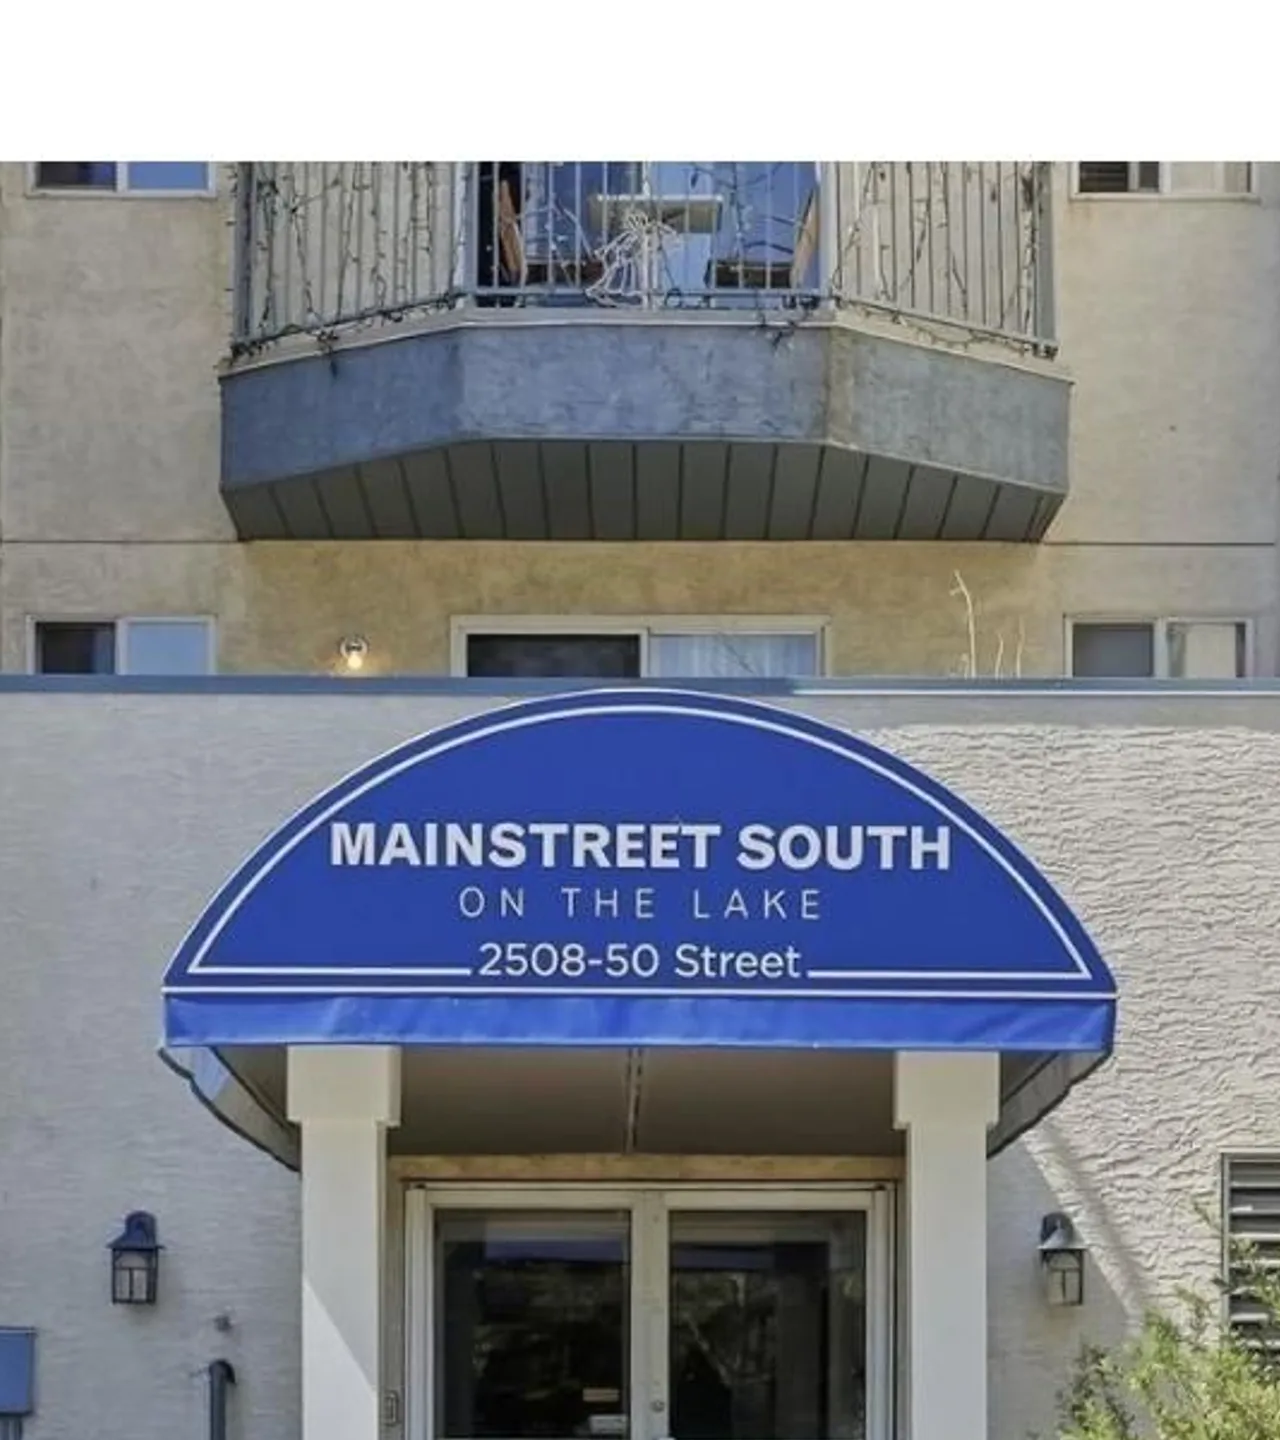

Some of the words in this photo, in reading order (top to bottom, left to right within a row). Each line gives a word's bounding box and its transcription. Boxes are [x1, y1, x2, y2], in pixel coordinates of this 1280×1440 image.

[331, 822, 721, 868] MAINSTREET
[737, 824, 951, 870] SOUTH
[459, 887, 525, 918] ON
[561, 887, 654, 919] THE
[693, 889, 820, 919] LAKE
[479, 942, 660, 977] 2508-50
[675, 942, 801, 978] Street
